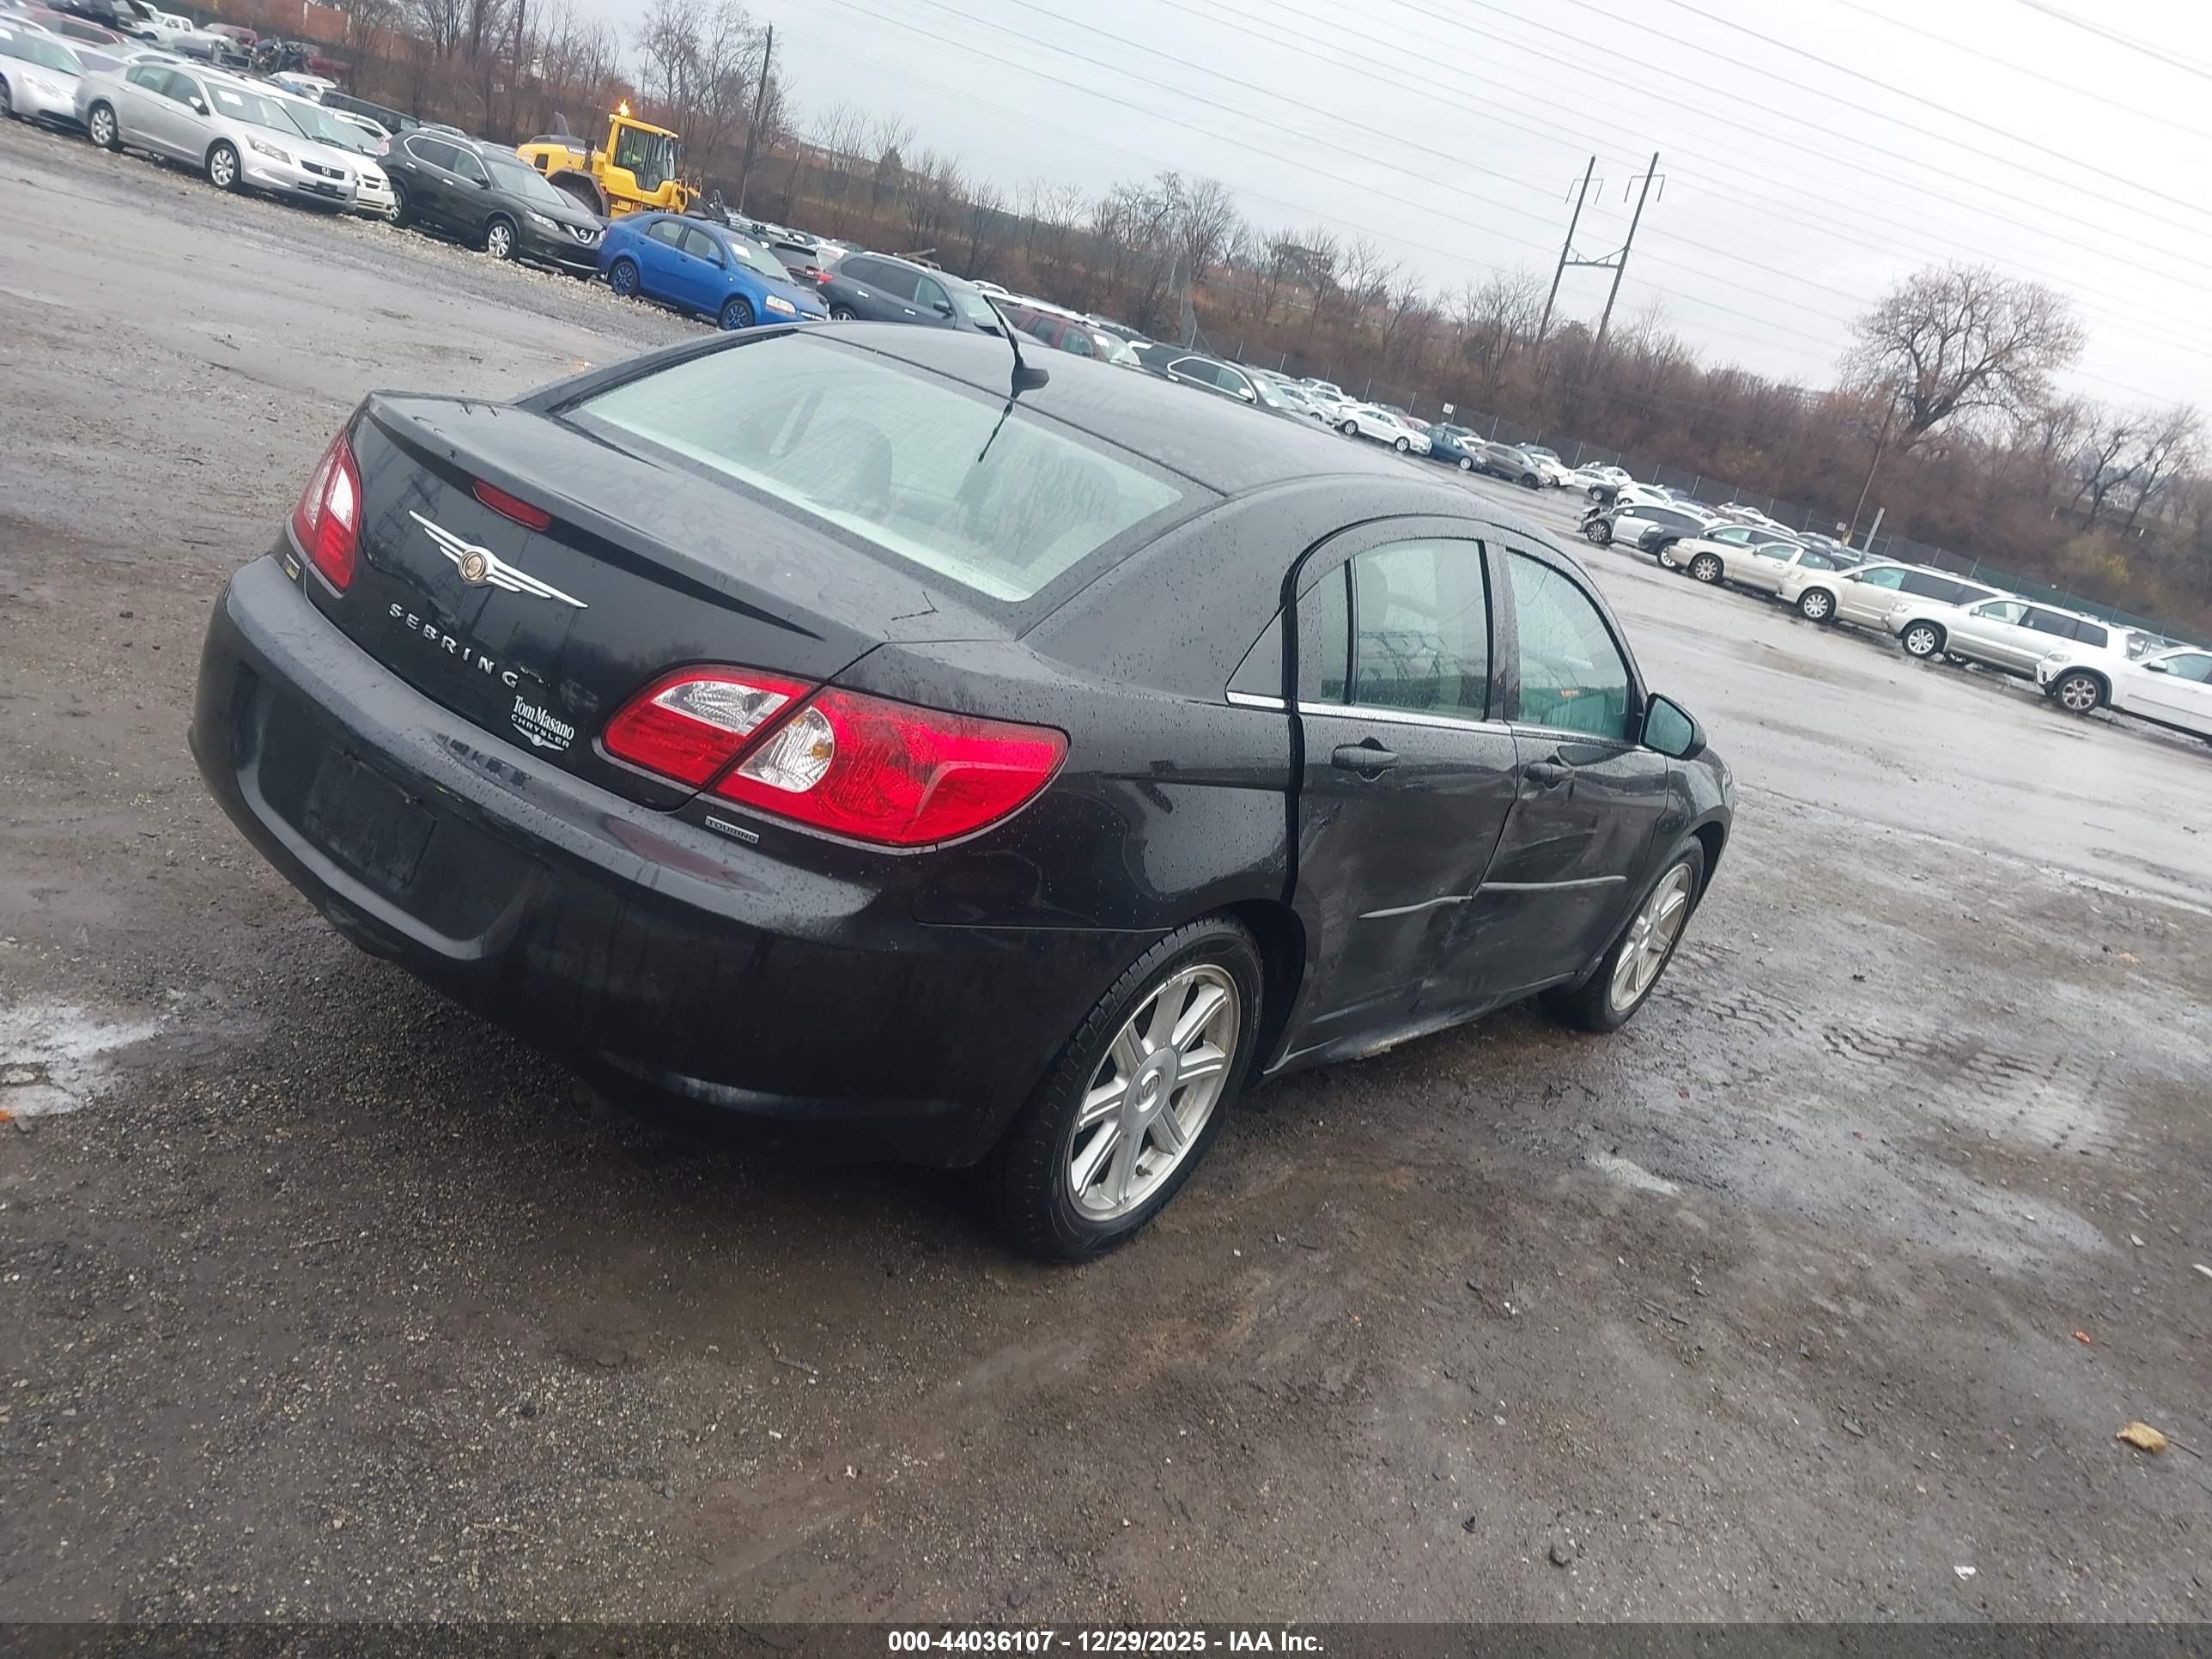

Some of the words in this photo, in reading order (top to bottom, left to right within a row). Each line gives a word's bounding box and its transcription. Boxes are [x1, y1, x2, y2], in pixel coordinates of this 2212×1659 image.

[388, 603, 519, 688] SEBRING
[511, 714, 570, 748] CHRYSLER
[707, 818, 757, 842] TOURING
